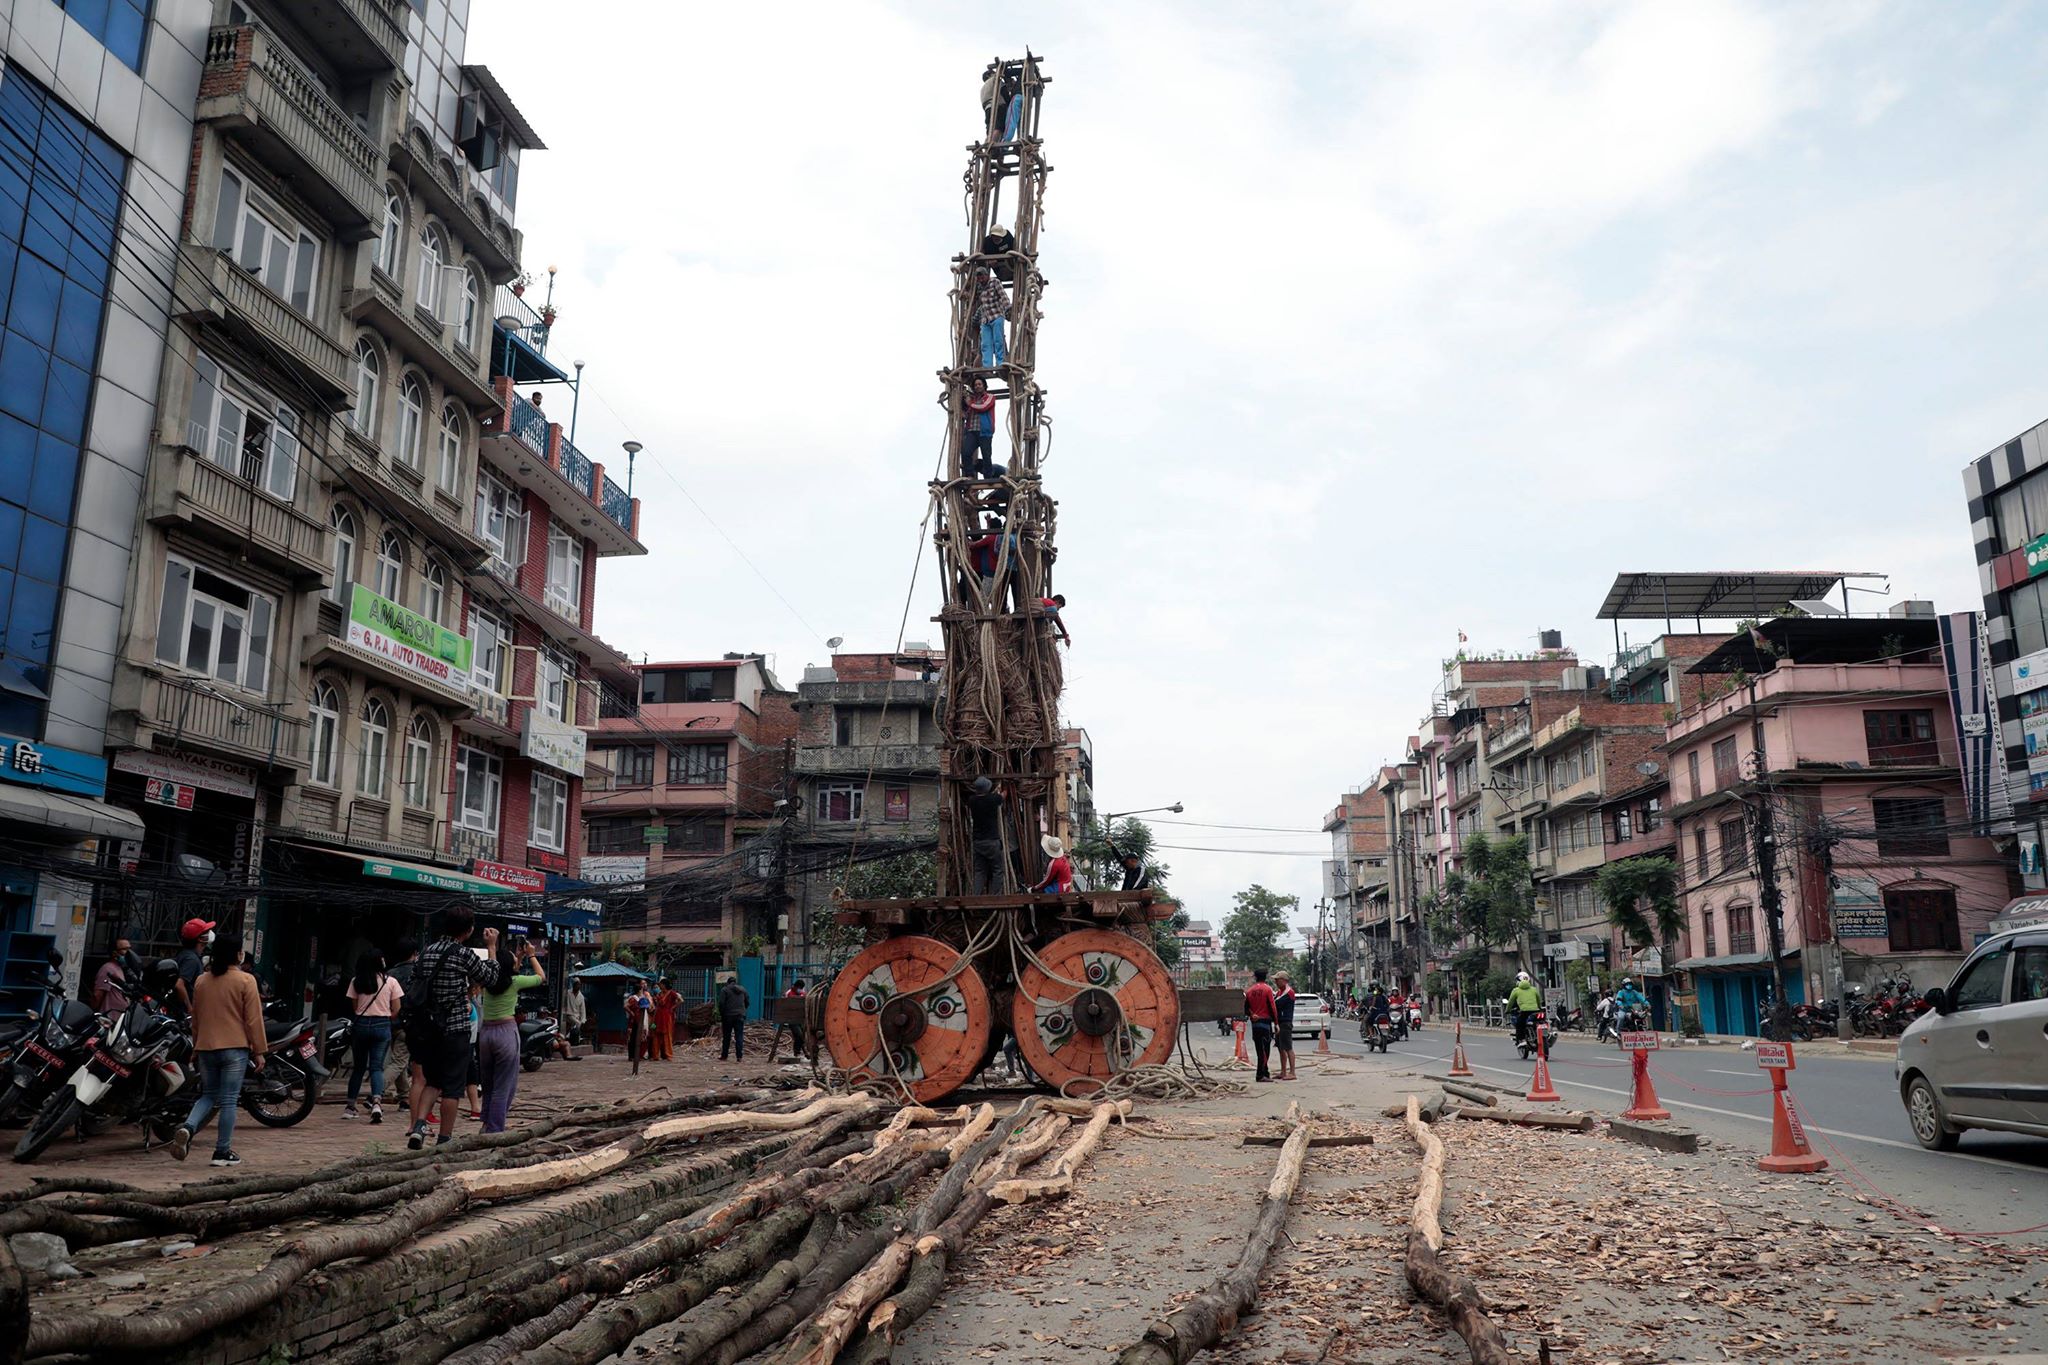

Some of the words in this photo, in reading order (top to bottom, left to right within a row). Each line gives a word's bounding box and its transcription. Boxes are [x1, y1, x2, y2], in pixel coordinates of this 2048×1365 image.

[369, 598, 435, 647] AMARON
[392, 643, 413, 665] AUTO
[415, 653, 449, 679] TRADERS
[1976, 614, 1985, 653] Variety
[1983, 657, 1993, 695] Paints
[1990, 700, 2002, 752] Pulchowk
[1964, 720, 1984, 729] Berger
[154, 746, 208, 767] BINAYAK
[210, 760, 247, 776] STORE
[230, 822, 247, 872] Home
[436, 877, 464, 889] TRADERS
[480, 864, 488, 878] A
[506, 869, 541, 887] Collection
[593, 873, 635, 883] JAPAN
